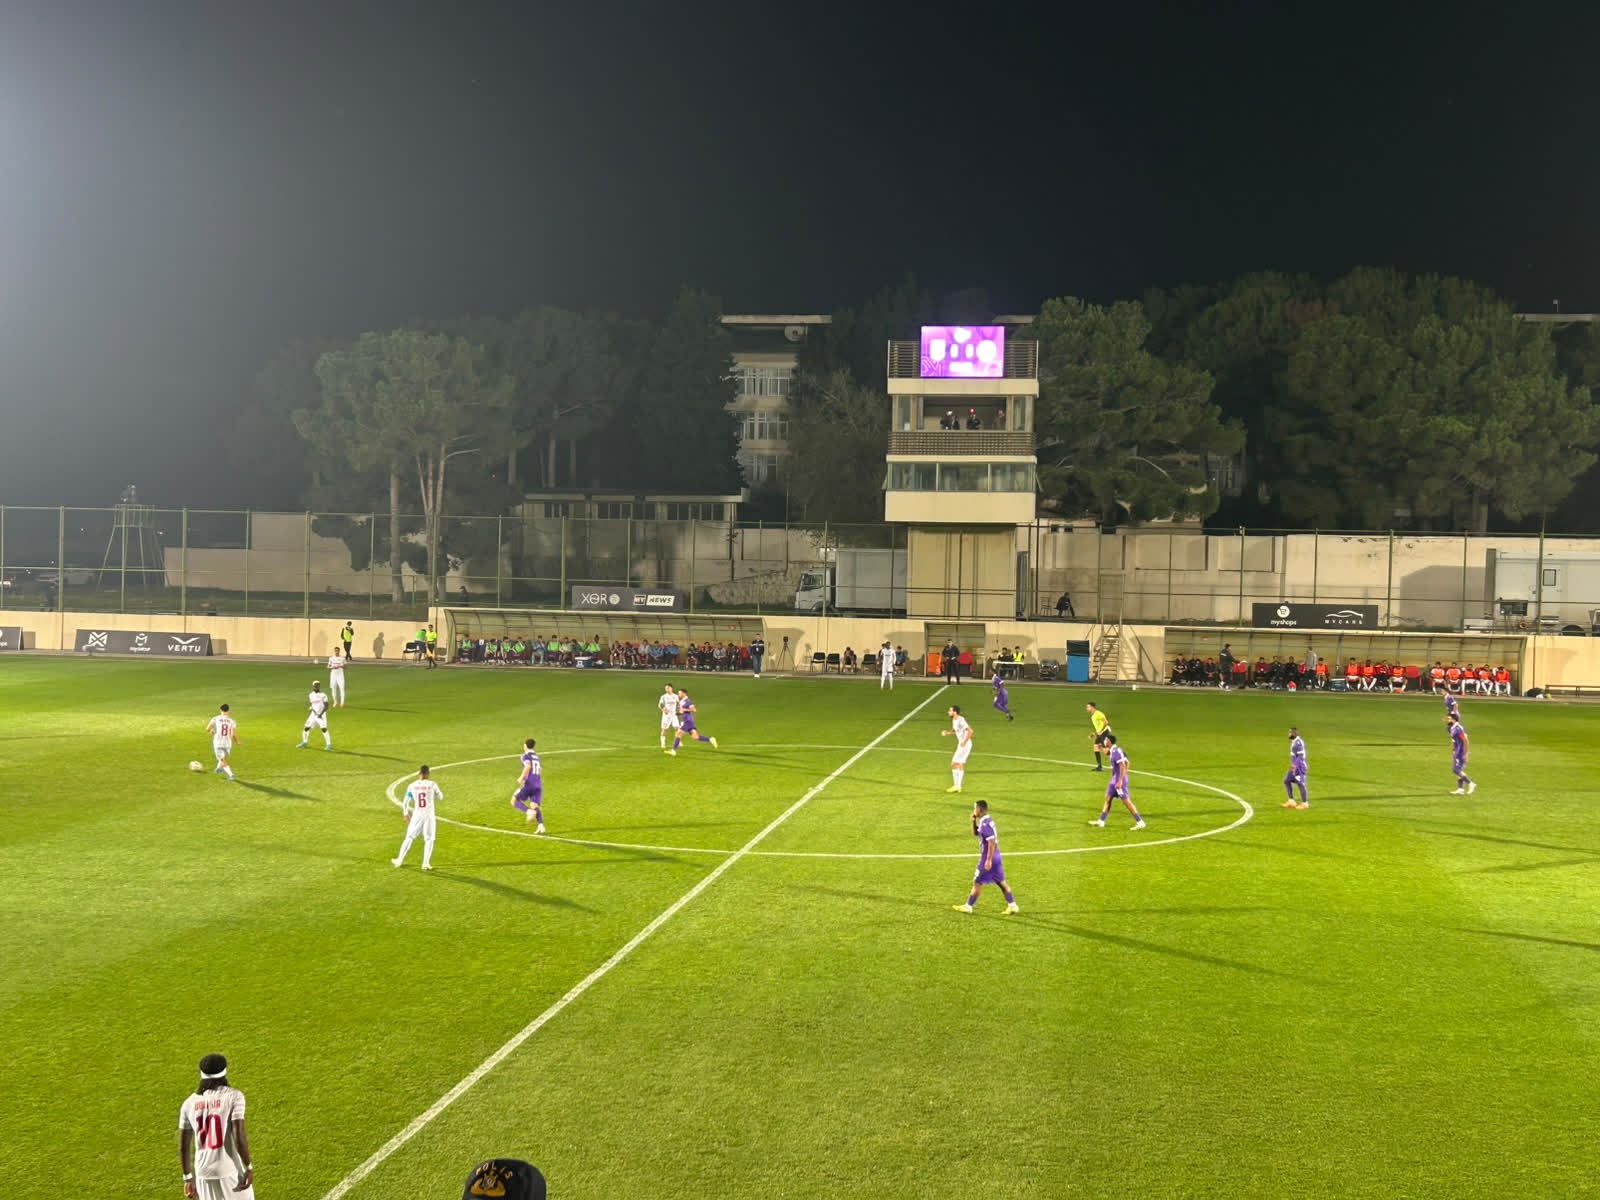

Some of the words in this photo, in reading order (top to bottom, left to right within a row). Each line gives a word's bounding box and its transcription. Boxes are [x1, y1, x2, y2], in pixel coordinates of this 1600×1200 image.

[168, 644, 201, 652] VERTU
[221, 723, 228, 736] 8
[418, 792, 426, 808] 6
